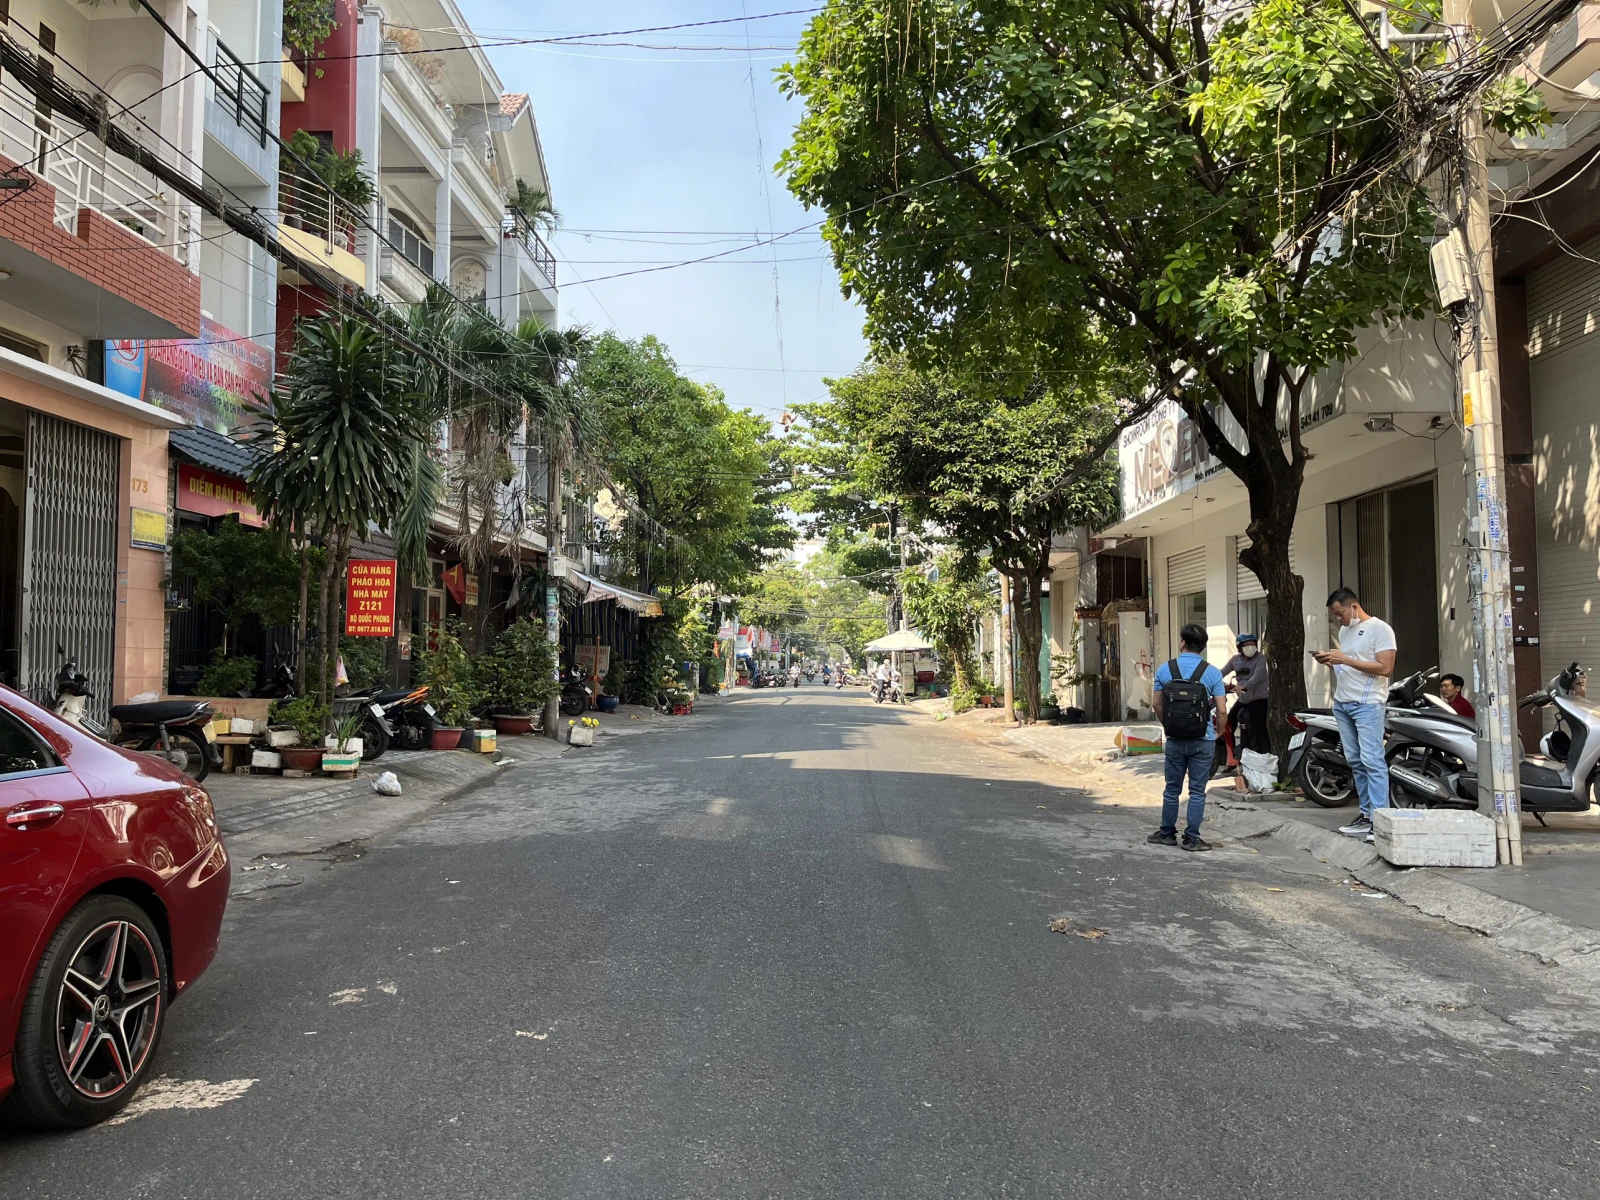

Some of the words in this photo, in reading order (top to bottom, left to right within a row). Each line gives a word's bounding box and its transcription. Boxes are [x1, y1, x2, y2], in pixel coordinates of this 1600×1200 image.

[1300, 415, 1312, 430] 543
[1312, 409, 1320, 423] 41
[131, 478, 148, 494] 173
[189, 475, 214, 498] ĐIỂM
[216, 484, 234, 504] BÁN
[352, 564, 368, 574] CỬA
[370, 564, 392, 574] HÀNG
[352, 576, 372, 586] PHÁO
[374, 578, 390, 586] HOA
[353, 588, 370, 598] NHÀ
[372, 588, 388, 598] MÁY
[360, 600, 382, 611] Z121
[350, 613, 358, 624] BỘ
[358, 612, 372, 623] QUỐC
[373, 614, 390, 623] PHÒNG
